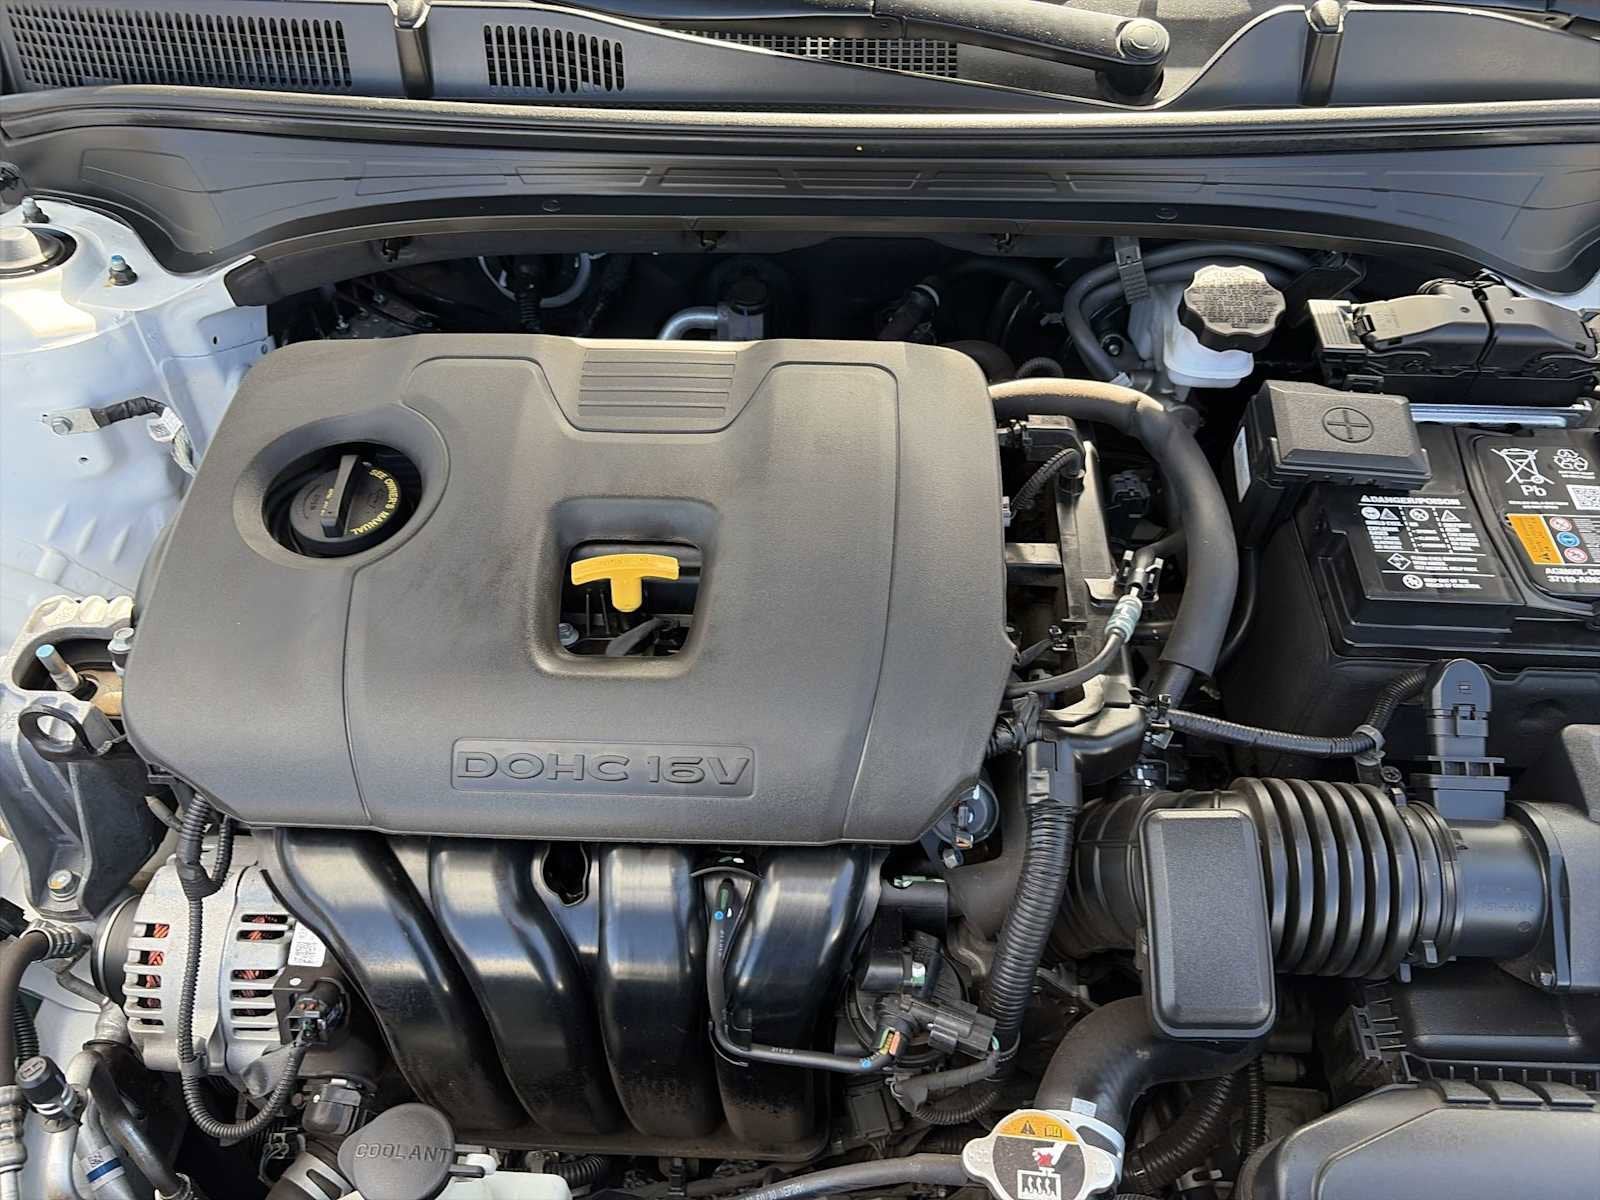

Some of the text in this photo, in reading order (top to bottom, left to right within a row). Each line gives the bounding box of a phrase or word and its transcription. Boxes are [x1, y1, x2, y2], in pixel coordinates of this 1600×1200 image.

[369, 469, 388, 481] SEE
[1520, 484, 1547, 496] Pb
[351, 511, 390, 535] MANUAL
[456, 751, 750, 785] DOHC 16V
[354, 1143, 452, 1163] COOLANT
